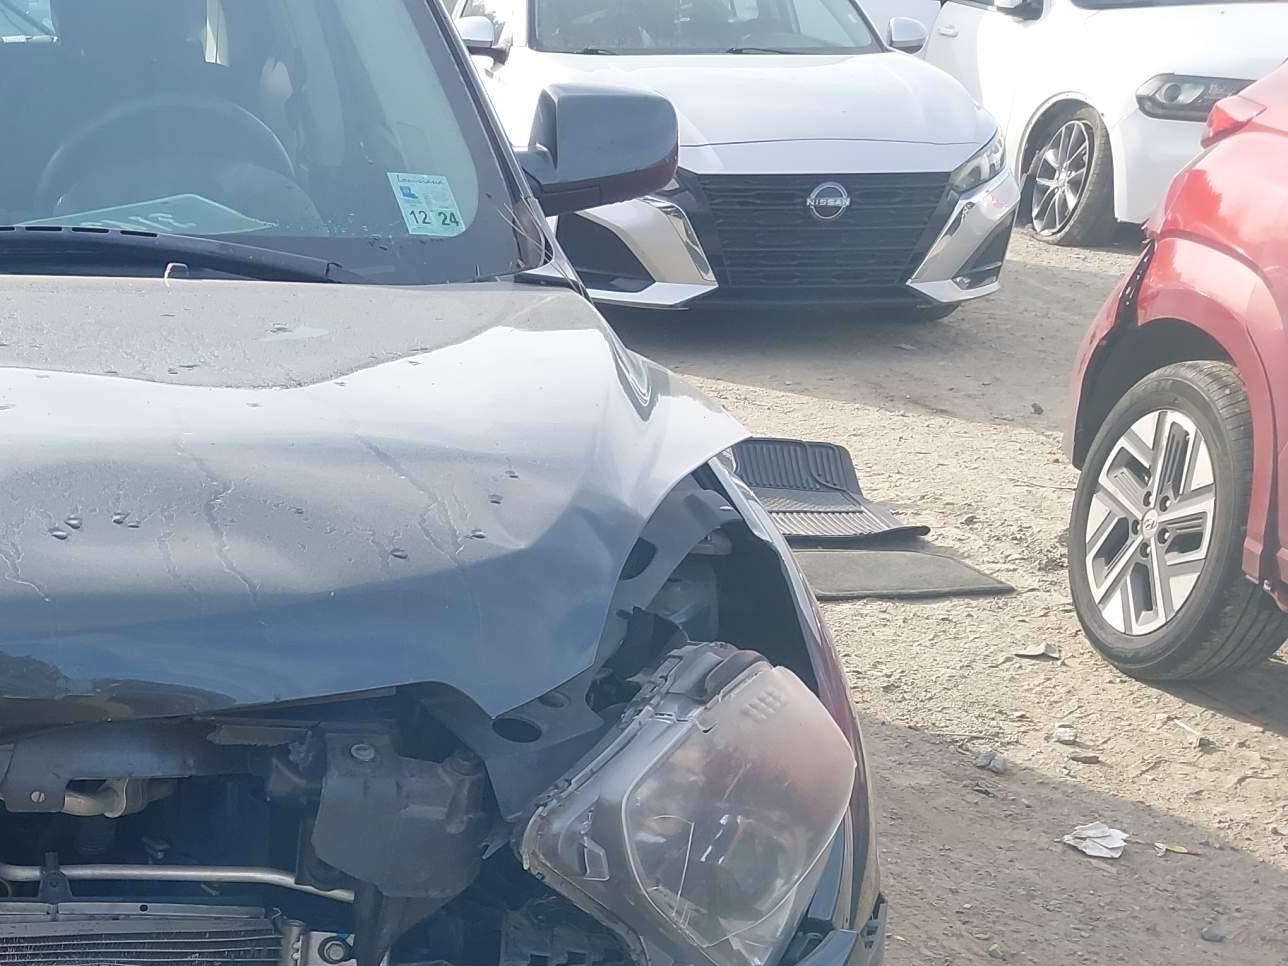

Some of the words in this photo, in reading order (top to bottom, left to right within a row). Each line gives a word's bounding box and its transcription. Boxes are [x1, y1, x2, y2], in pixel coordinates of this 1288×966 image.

[806, 197, 850, 207] NISSAN
[409, 210, 432, 225] 12
[438, 211, 460, 226] 24
